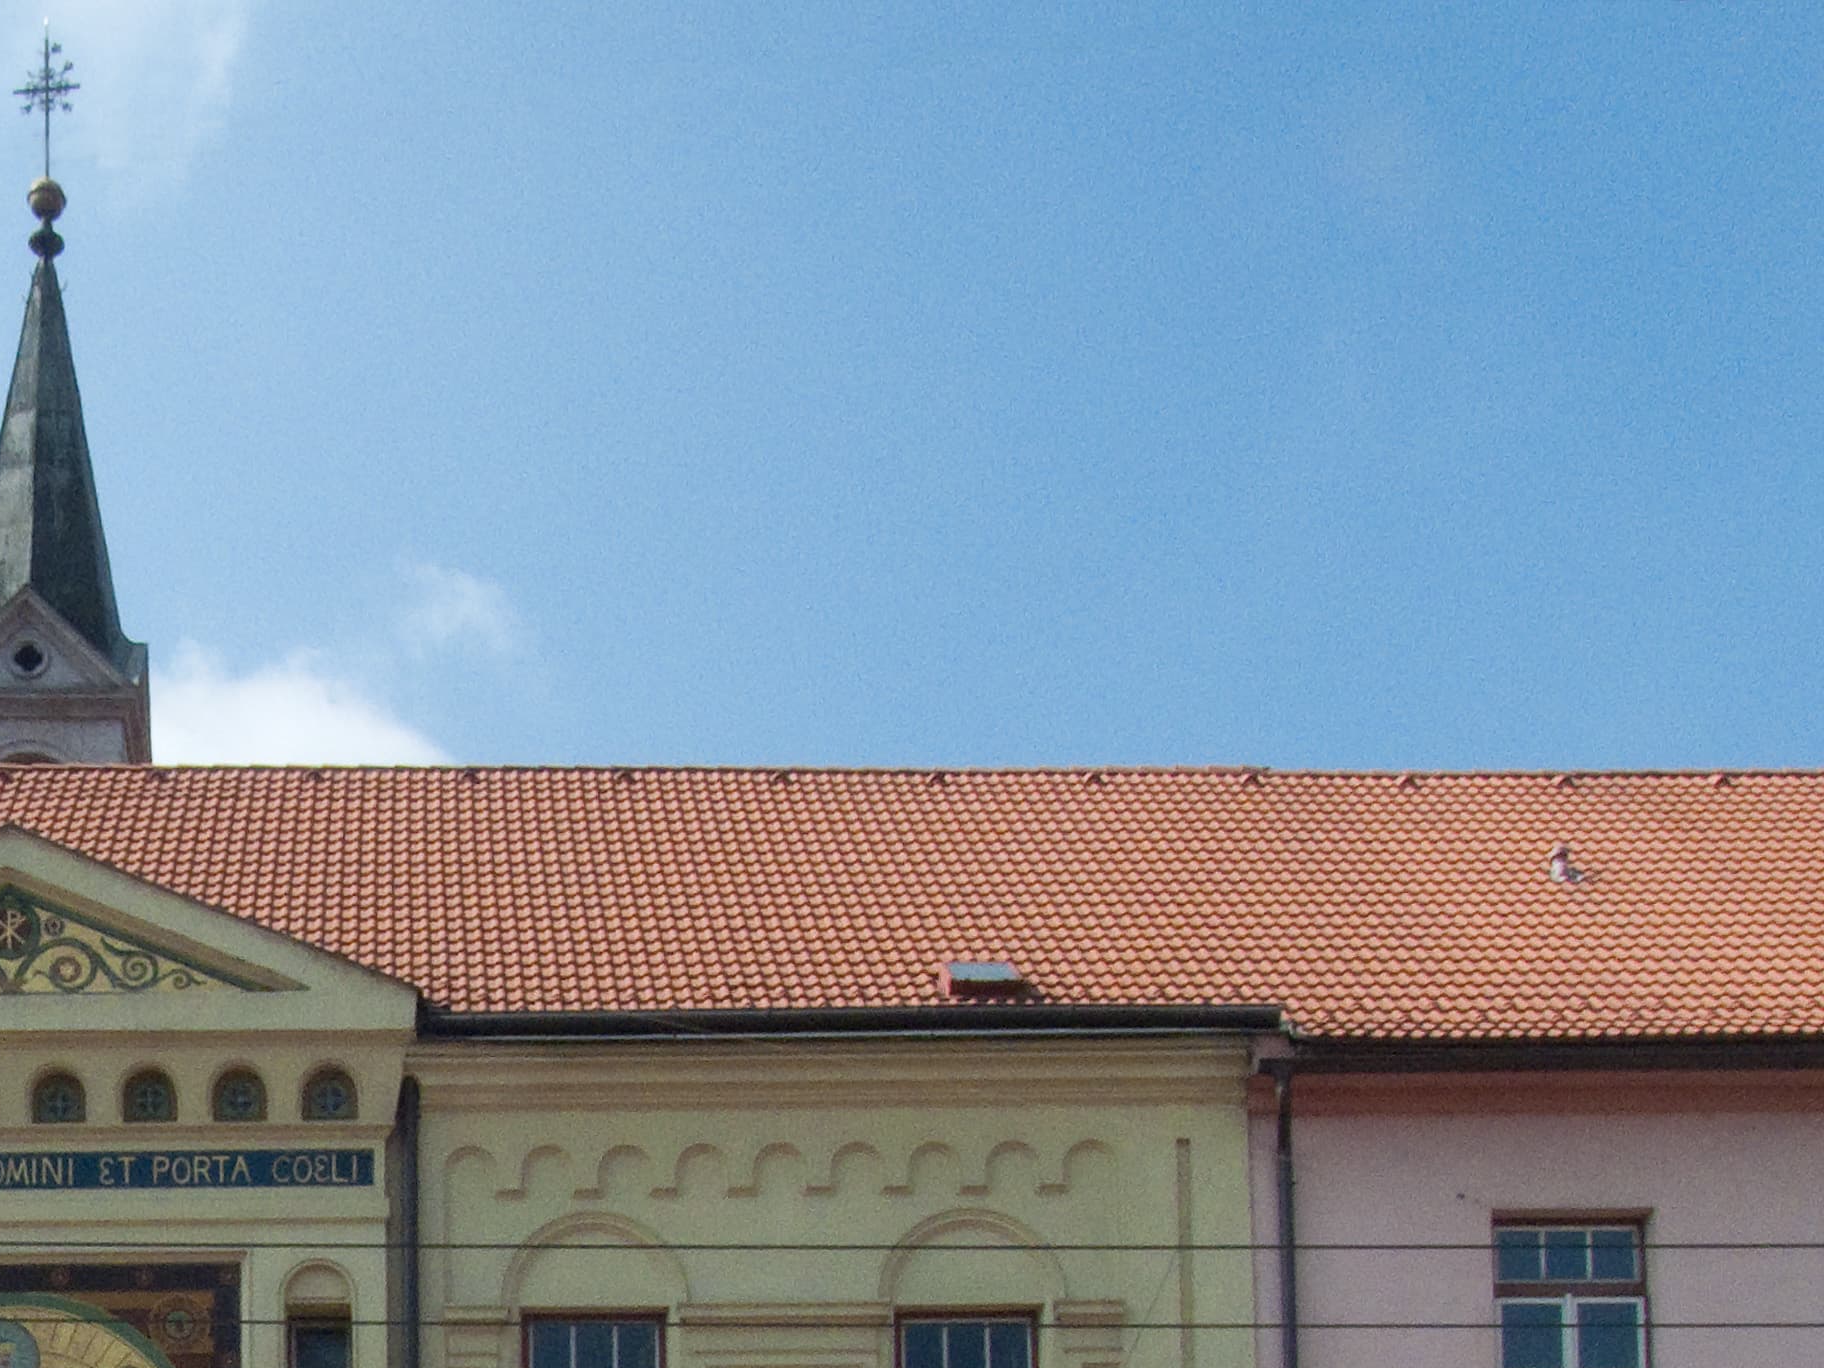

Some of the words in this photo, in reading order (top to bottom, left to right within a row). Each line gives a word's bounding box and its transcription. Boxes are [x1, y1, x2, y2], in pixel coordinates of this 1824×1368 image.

[98, 1156, 137, 1184] ET
[151, 1155, 252, 1185] PORTA
[271, 1155, 358, 1184] COELI
